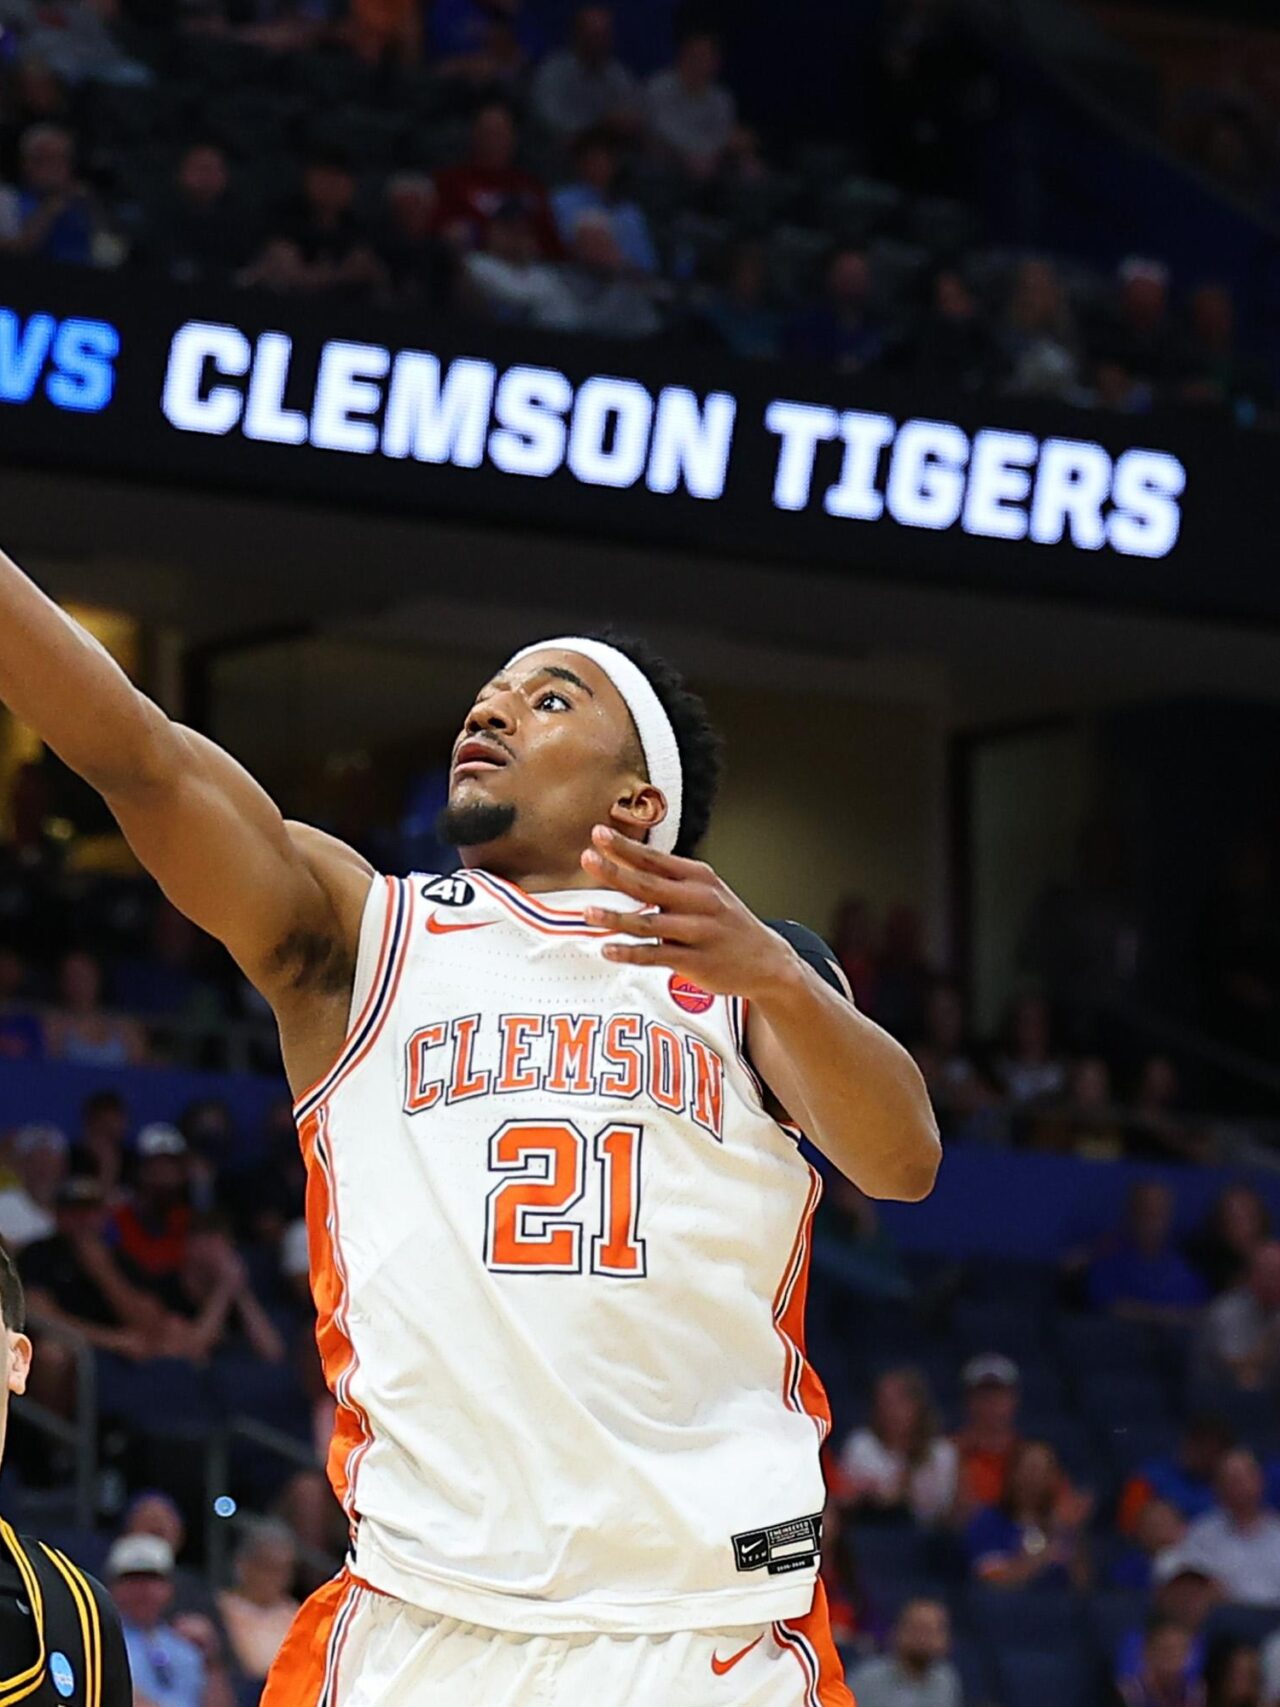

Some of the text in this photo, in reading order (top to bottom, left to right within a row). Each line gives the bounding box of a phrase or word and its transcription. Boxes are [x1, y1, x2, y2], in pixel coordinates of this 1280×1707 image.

[160, 318, 738, 501] CLEMSON
[764, 399, 1187, 559] TIGERS
[424, 879, 467, 904] 41
[403, 1013, 724, 1143] CLEMSON
[483, 1118, 647, 1279] 21
